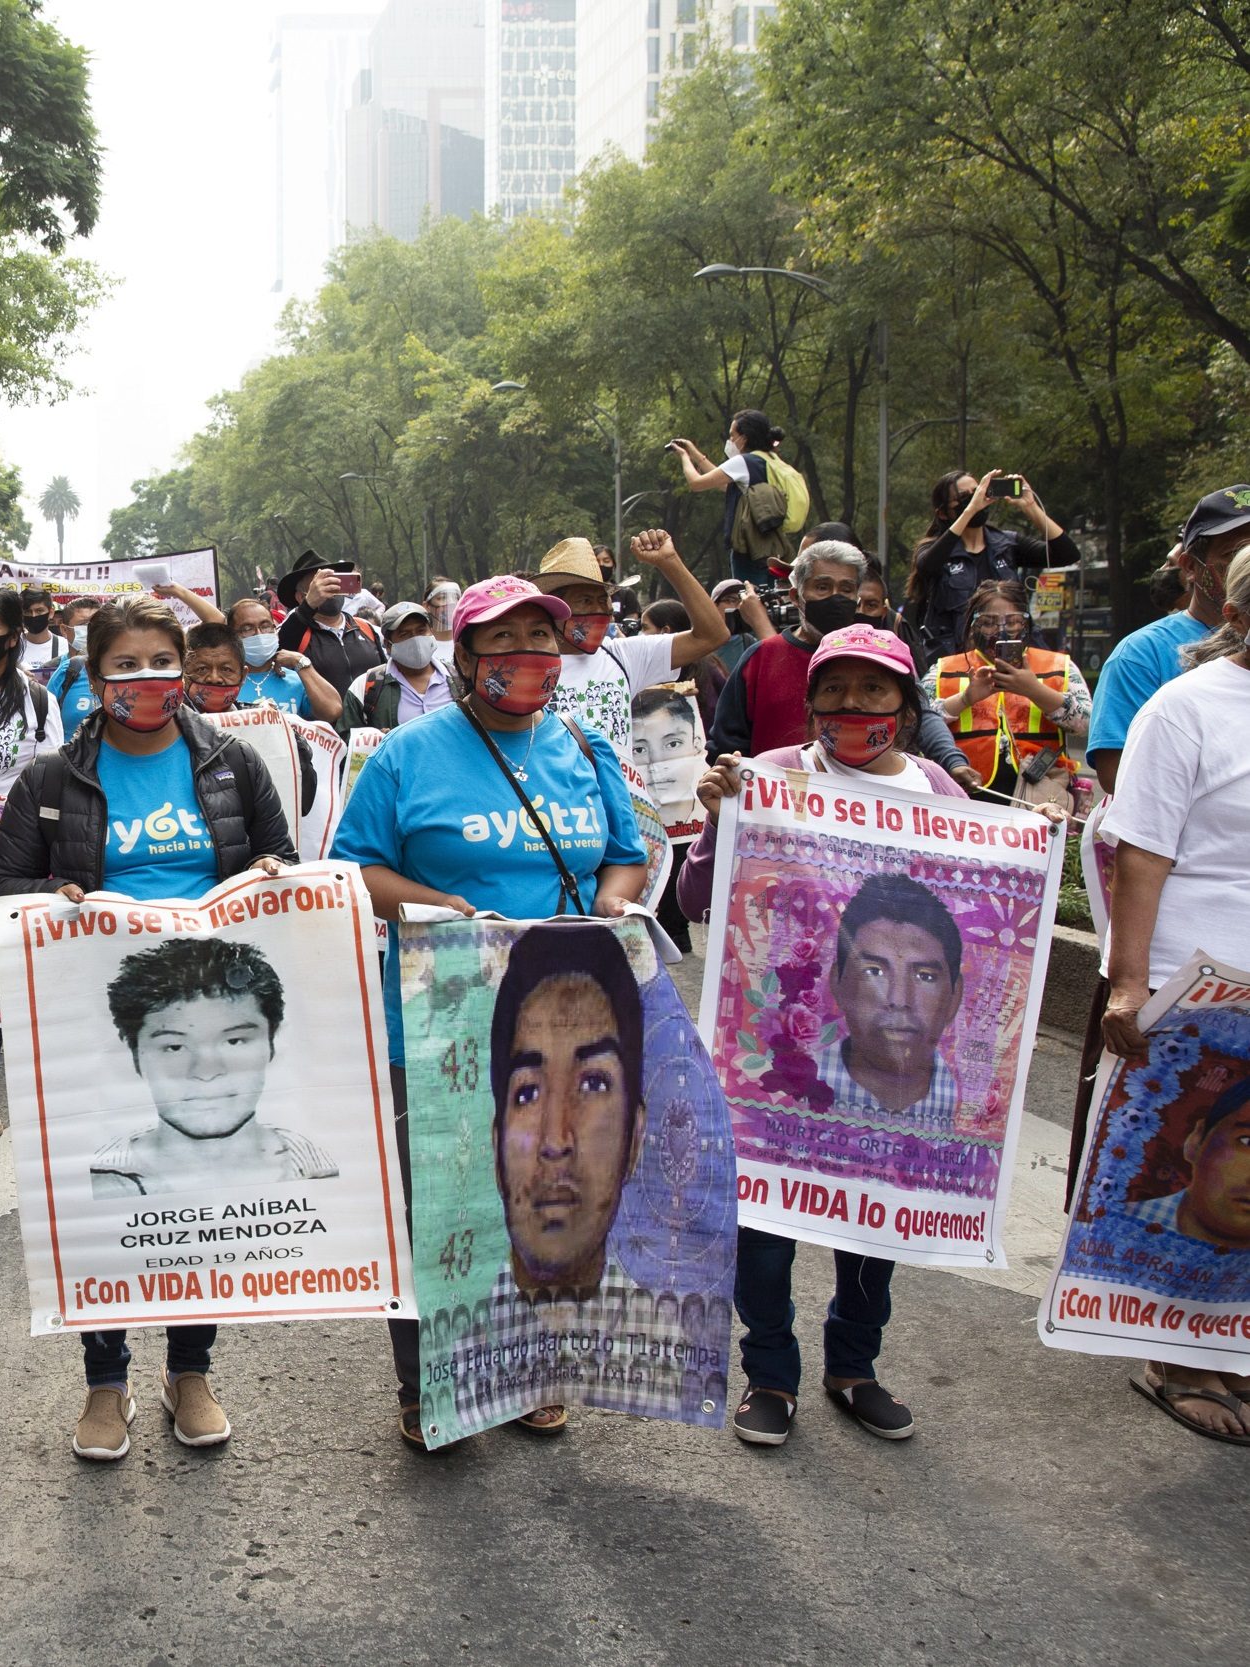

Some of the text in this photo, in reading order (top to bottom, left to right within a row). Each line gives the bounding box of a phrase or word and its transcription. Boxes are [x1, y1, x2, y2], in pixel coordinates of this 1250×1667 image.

[18, 567, 92, 580] MEZTLI
[44, 583, 100, 594] ESTADO
[103, 582, 143, 593] ASES
[161, 693, 179, 713] 43
[866, 728, 889, 747] 43
[461, 794, 602, 848] ayotzi
[743, 776, 1048, 854] ¡Vivo se lo llevaron!
[149, 839, 186, 855] hacia
[188, 838, 202, 850] la
[524, 839, 572, 852] hac la
[745, 832, 759, 843] Yo
[764, 835, 782, 846] Jan
[33, 880, 346, 948] ¡Vivo se lo llevaron!
[440, 1036, 480, 1093] 43
[764, 1119, 968, 1167] MAURICIO ORTEGA VALERIO
[766, 1137, 793, 1152] Hijo
[797, 1143, 811, 1153] de
[739, 1145, 751, 1154] de
[756, 1150, 794, 1164] origen
[862, 1169, 896, 1183] Monte
[126, 1197, 317, 1228] JORGE ANÍBAL
[737, 1174, 986, 1243] on VIDA lo queremos!
[120, 1218, 327, 1248] CRUZ MENDOZA
[145, 1246, 304, 1268] EDAD 19 AÑOS
[439, 1228, 475, 1281] 43
[74, 1261, 380, 1310] ¡Con VIDA lo queremos!
[1059, 1287, 1250, 1339] ¡Con VIDA lo quere
[426, 1328, 720, 1386] José Eduardo Bartolo Tlatempa
